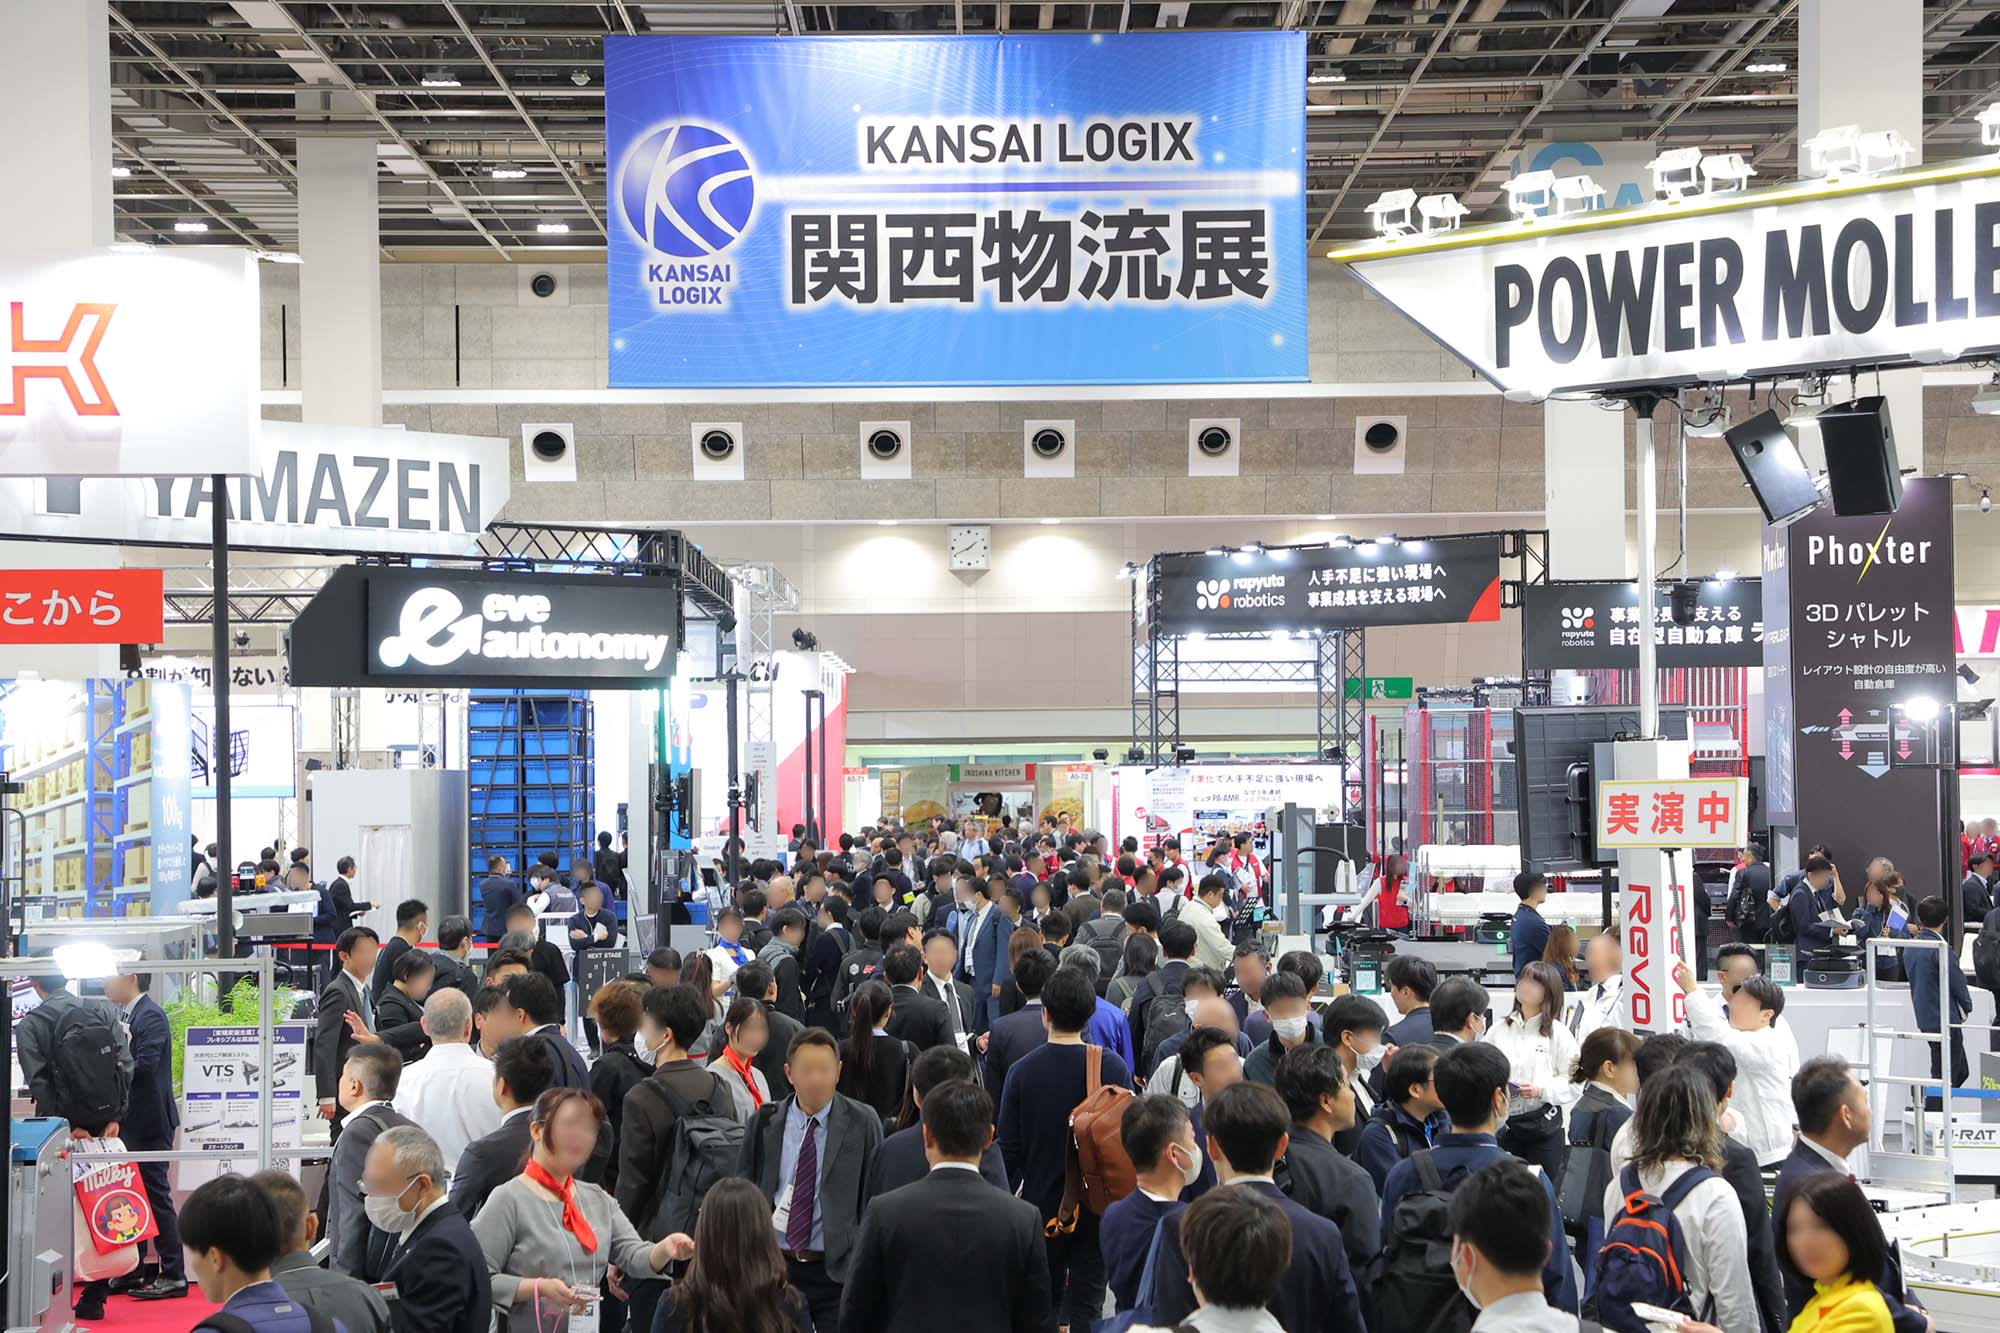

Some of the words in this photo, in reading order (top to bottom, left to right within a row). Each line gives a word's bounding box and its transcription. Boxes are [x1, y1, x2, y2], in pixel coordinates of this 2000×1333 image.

[866, 123, 1043, 164] KANSAI
[1058, 121, 1194, 162] LOGIX
[790, 208, 1271, 305] 関西物流展
[648, 263, 732, 283] KANSAI
[658, 285, 723, 305] LOGIX
[1495, 236, 1747, 369] POWER
[1763, 202, 2000, 341] MOLLE
[1808, 531, 1932, 571] Phoxter
[1234, 573, 1285, 592] rapyuta
[1308, 563, 1447, 587] 人手不足に強い現場へ
[3, 589, 122, 626] こから
[482, 592, 551, 622] eve
[1234, 593, 1286, 608] robotics
[1308, 586, 1447, 609] 事業成長を支える現場へ
[1562, 631, 1594, 640] rapyuta
[1827, 629, 1911, 649] シャトル
[482, 625, 669, 672] autonomy
[1803, 664, 1946, 676] レイアウト設計の自由度が高い
[1854, 679, 1895, 690] 自動倉庫
[1607, 790, 1731, 836] 実演中
[202, 1064, 234, 1077] VTS
